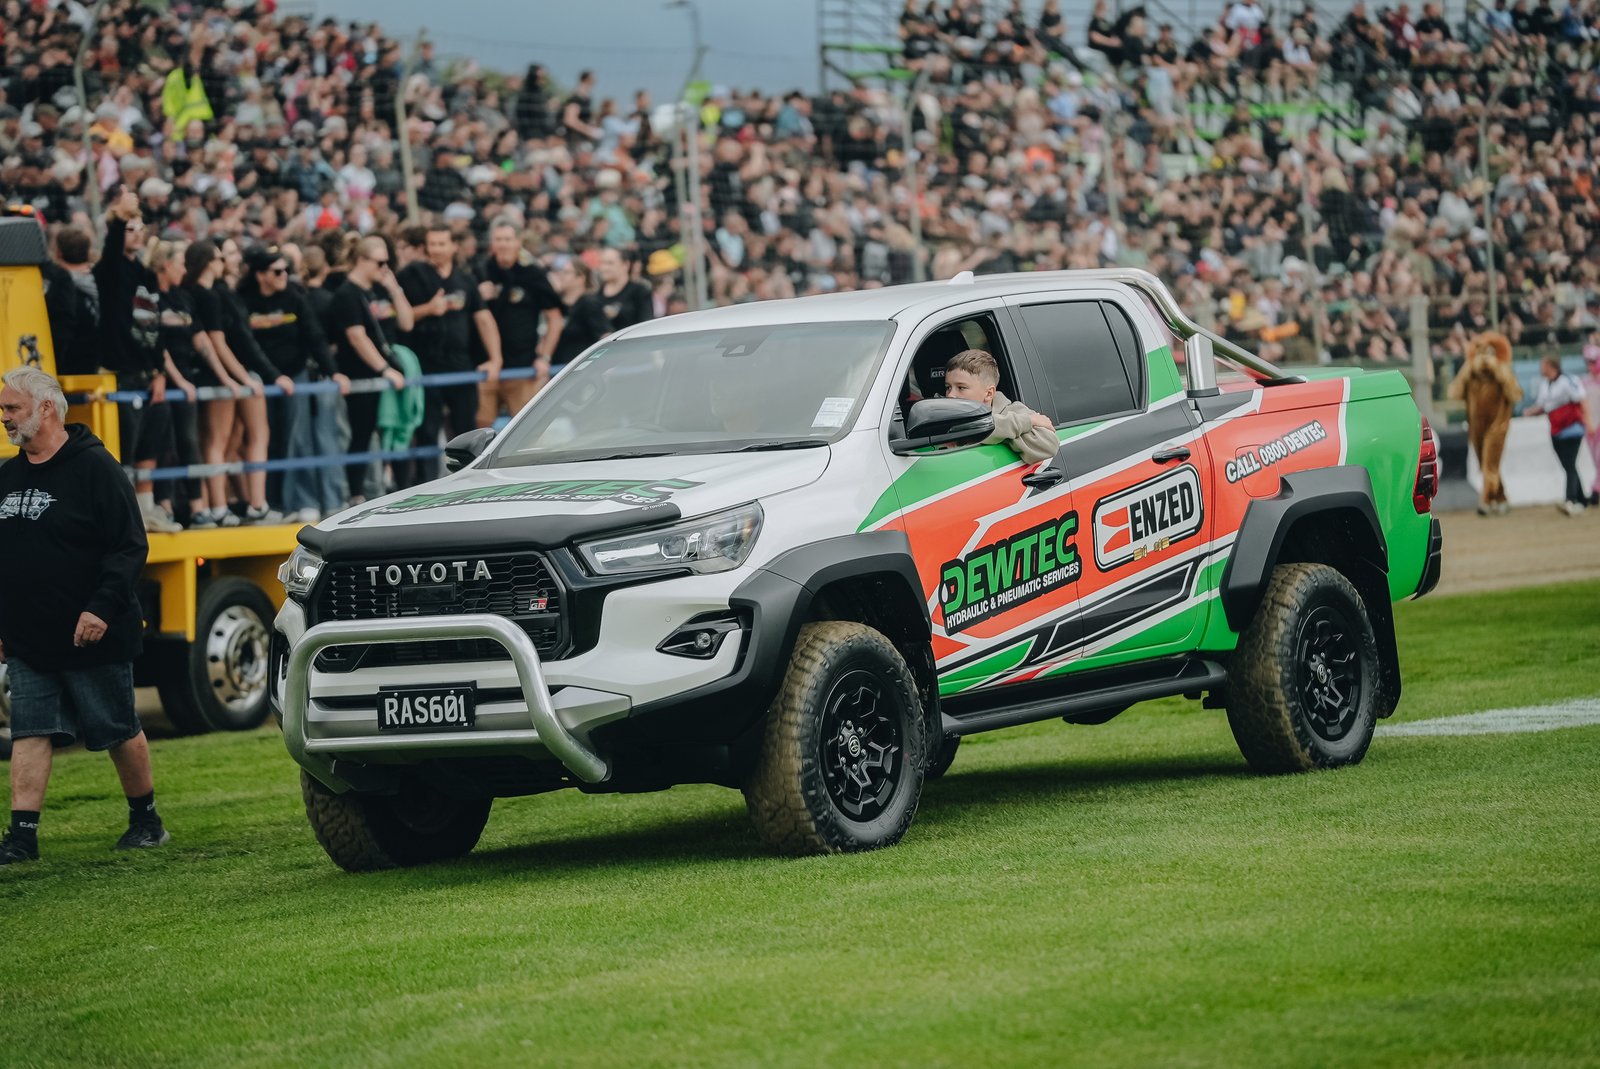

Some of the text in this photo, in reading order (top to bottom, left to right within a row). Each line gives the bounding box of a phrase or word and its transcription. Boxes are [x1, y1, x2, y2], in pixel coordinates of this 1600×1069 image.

[1226, 421, 1326, 482] CALL 0800 DEWTEC
[1130, 481, 1195, 542] ENZED
[366, 560, 492, 586] TOYOTA
[944, 518, 1076, 615] DEWTEC
[946, 561, 1079, 629] HYDRAULIC & PNEUMATIC SERVICES
[385, 694, 467, 725] RAS601
